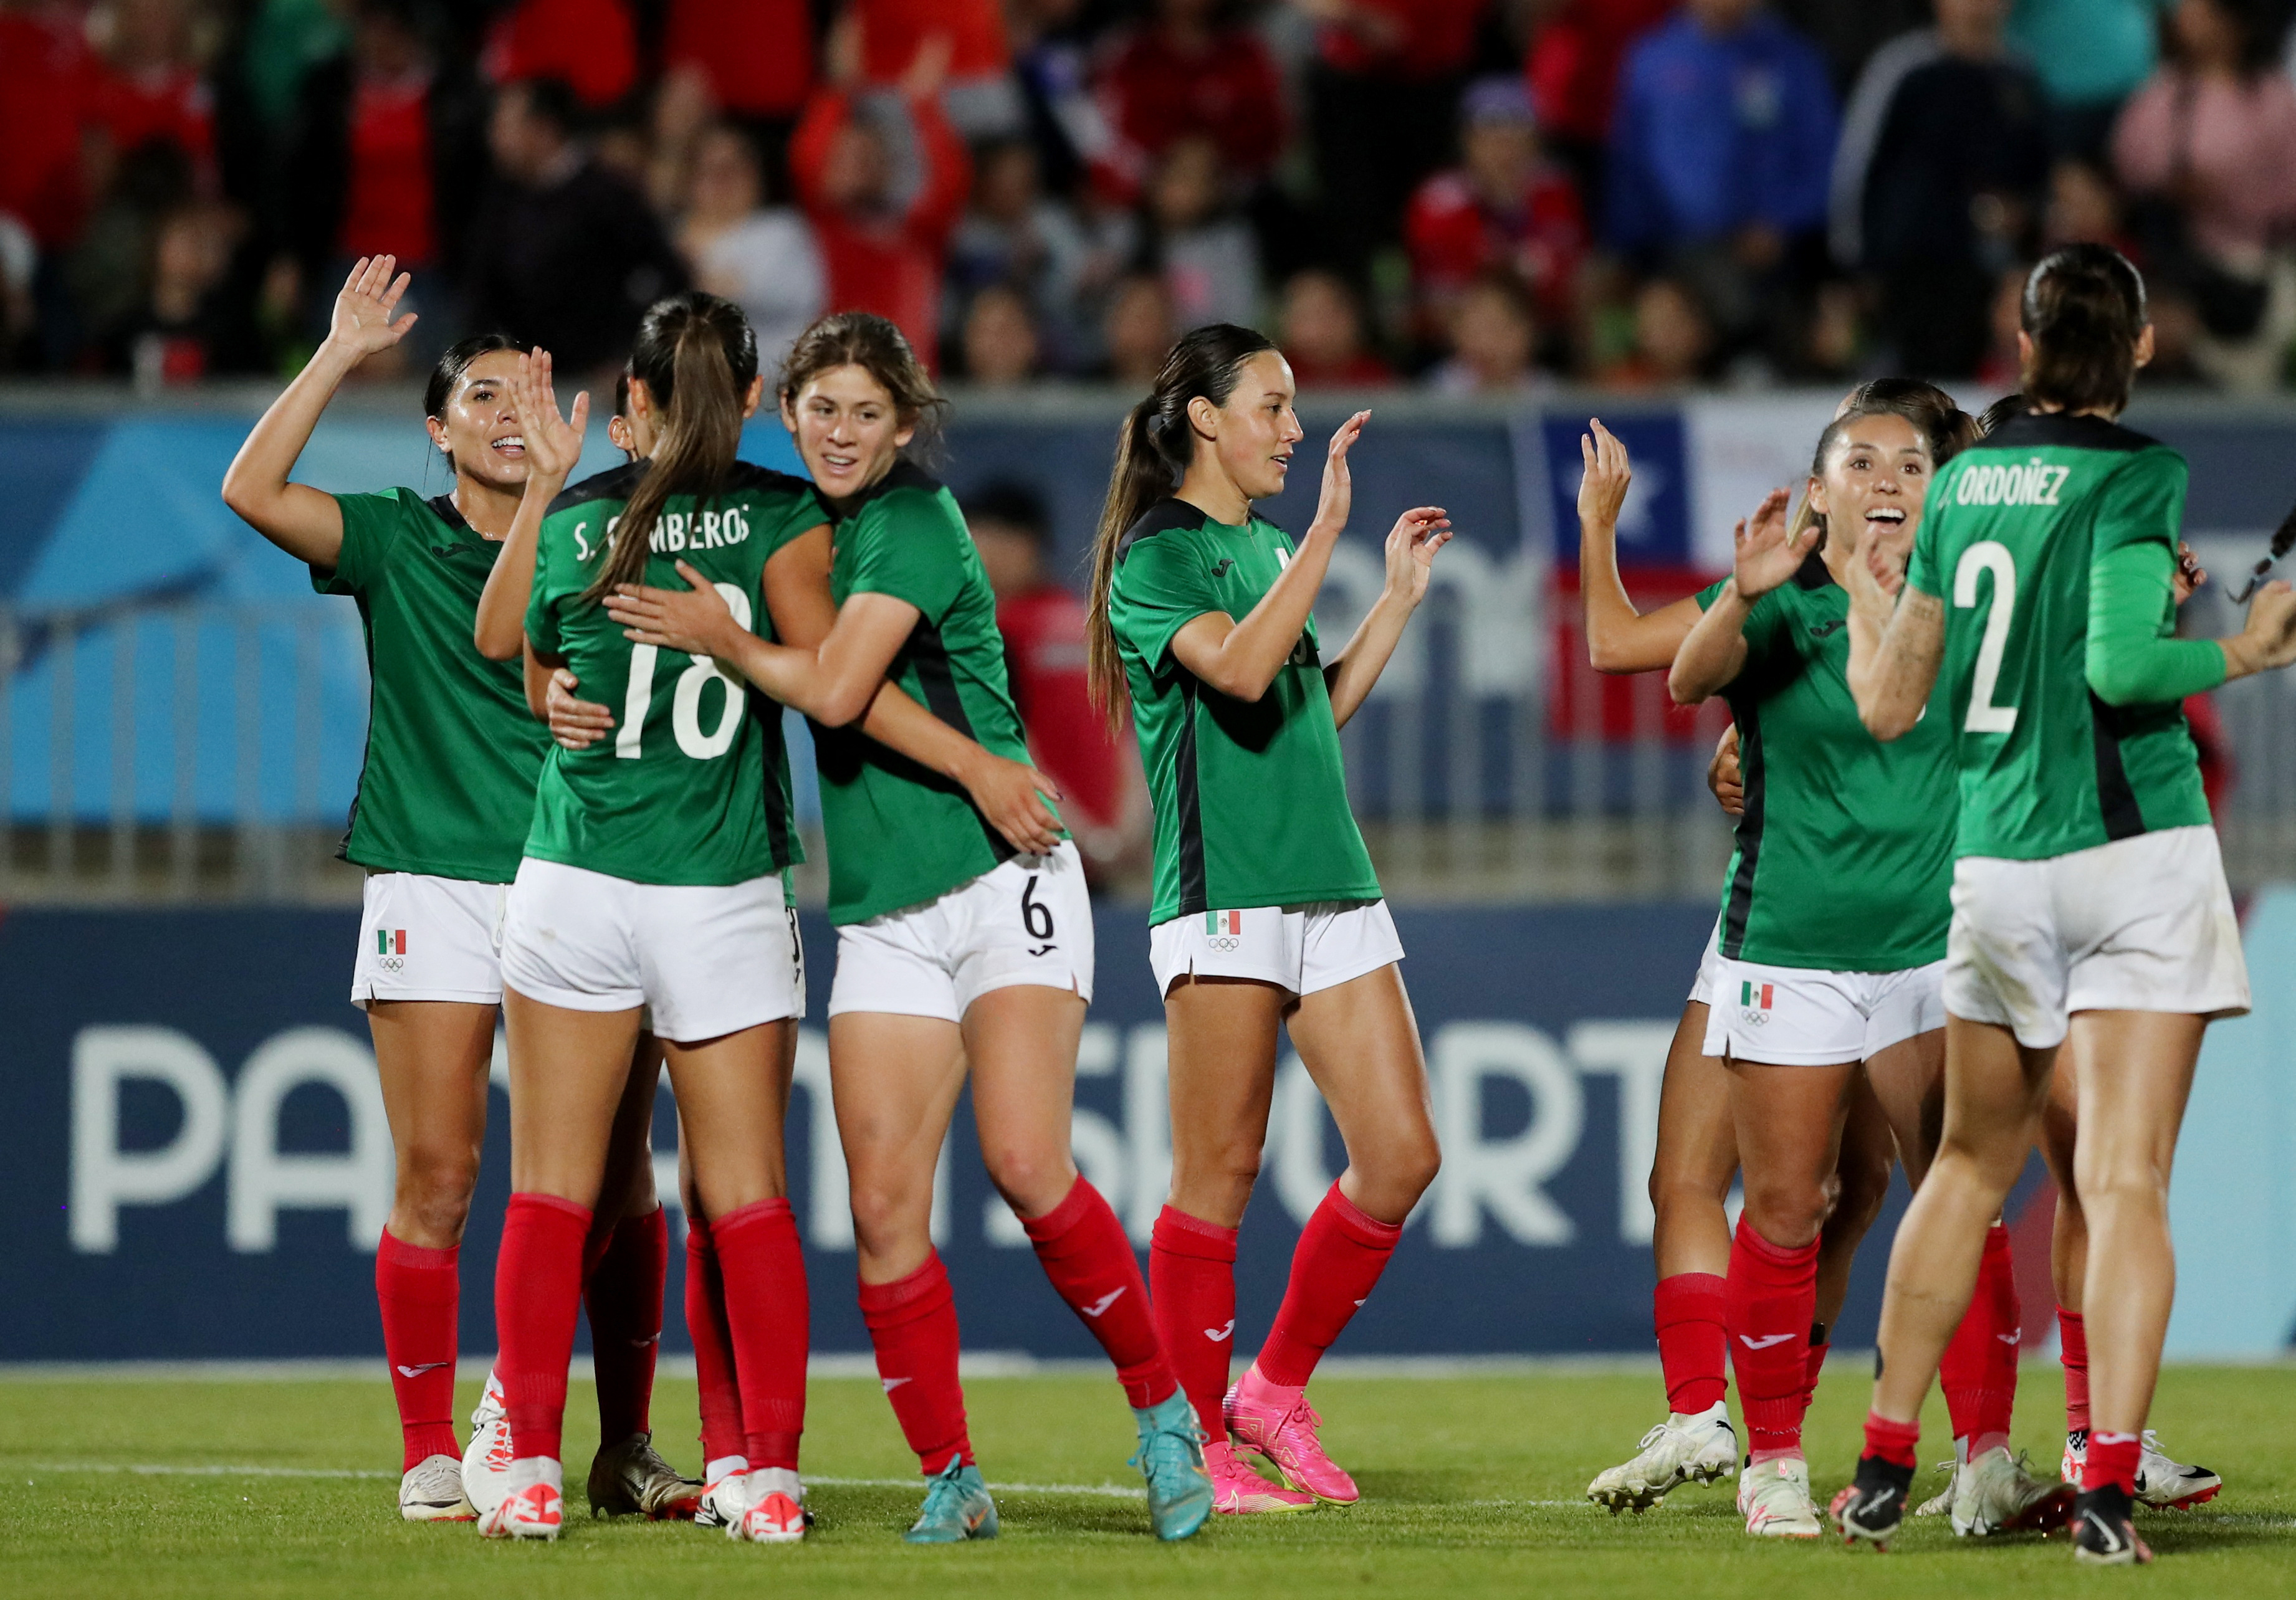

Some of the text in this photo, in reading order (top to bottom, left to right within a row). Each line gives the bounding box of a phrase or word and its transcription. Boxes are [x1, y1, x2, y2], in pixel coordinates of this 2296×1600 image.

[1956, 457, 2070, 506] ORDOÑEZ
[574, 521, 596, 561] S.
[1953, 540, 2019, 733] 2
[615, 582, 752, 760] 18
[1021, 875, 1054, 939] 6
